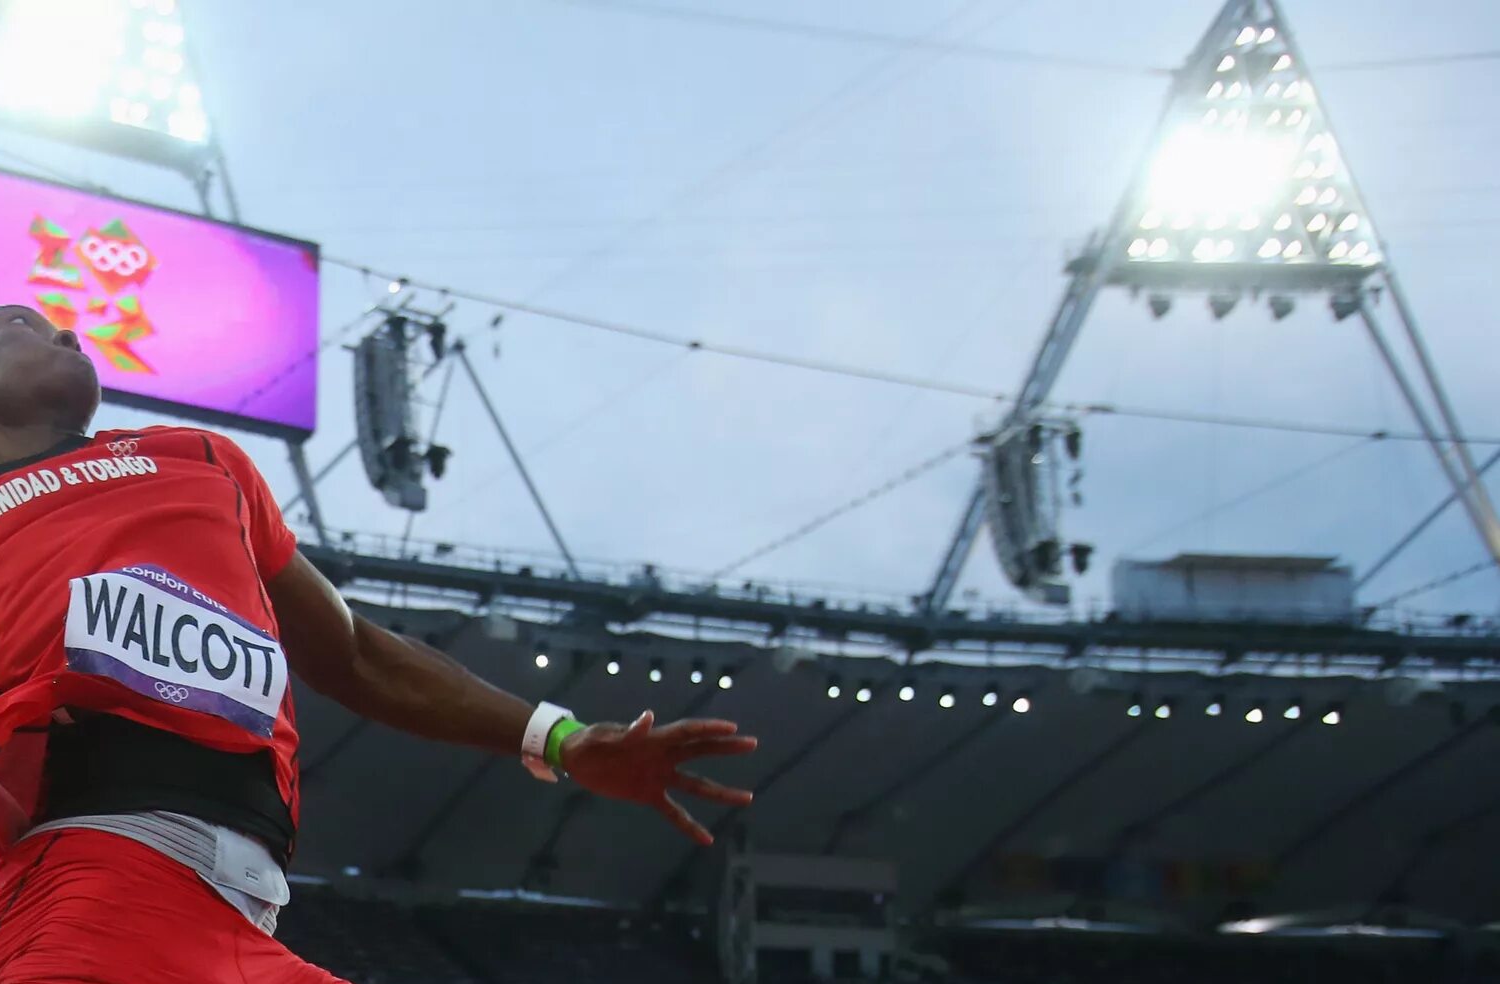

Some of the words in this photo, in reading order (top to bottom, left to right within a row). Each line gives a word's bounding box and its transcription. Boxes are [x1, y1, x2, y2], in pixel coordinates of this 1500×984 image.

[59, 467, 82, 485] &
[72, 456, 158, 483] TOBAGO
[82, 577, 276, 697] WALCOTT
